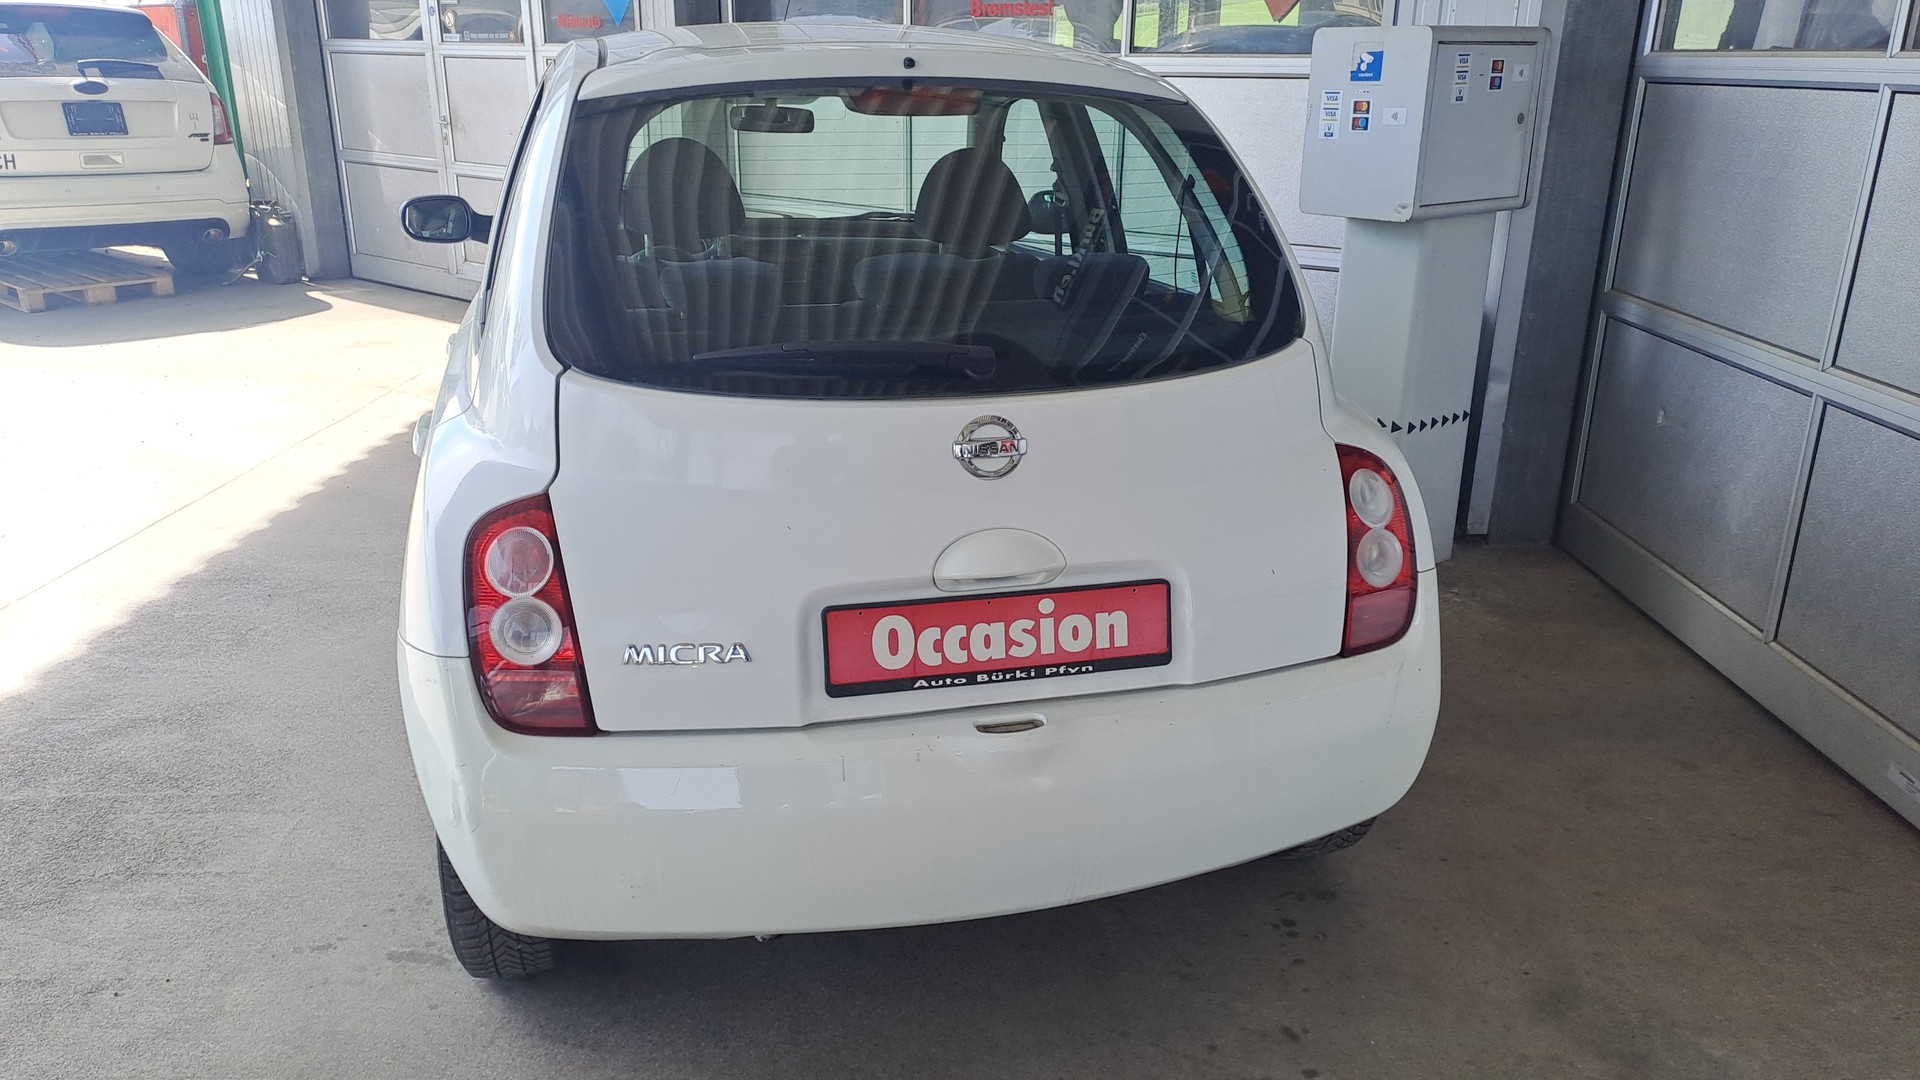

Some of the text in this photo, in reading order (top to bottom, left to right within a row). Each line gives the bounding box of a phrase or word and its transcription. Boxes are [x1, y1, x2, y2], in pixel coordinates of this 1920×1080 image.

[970, 0, 1054, 17] Bremstest
[960, 442, 1019, 458] NISSAN
[871, 597, 1129, 671] Occasion
[622, 642, 752, 665] MICRA
[913, 663, 1094, 689] Auto Bürki Pfyn
